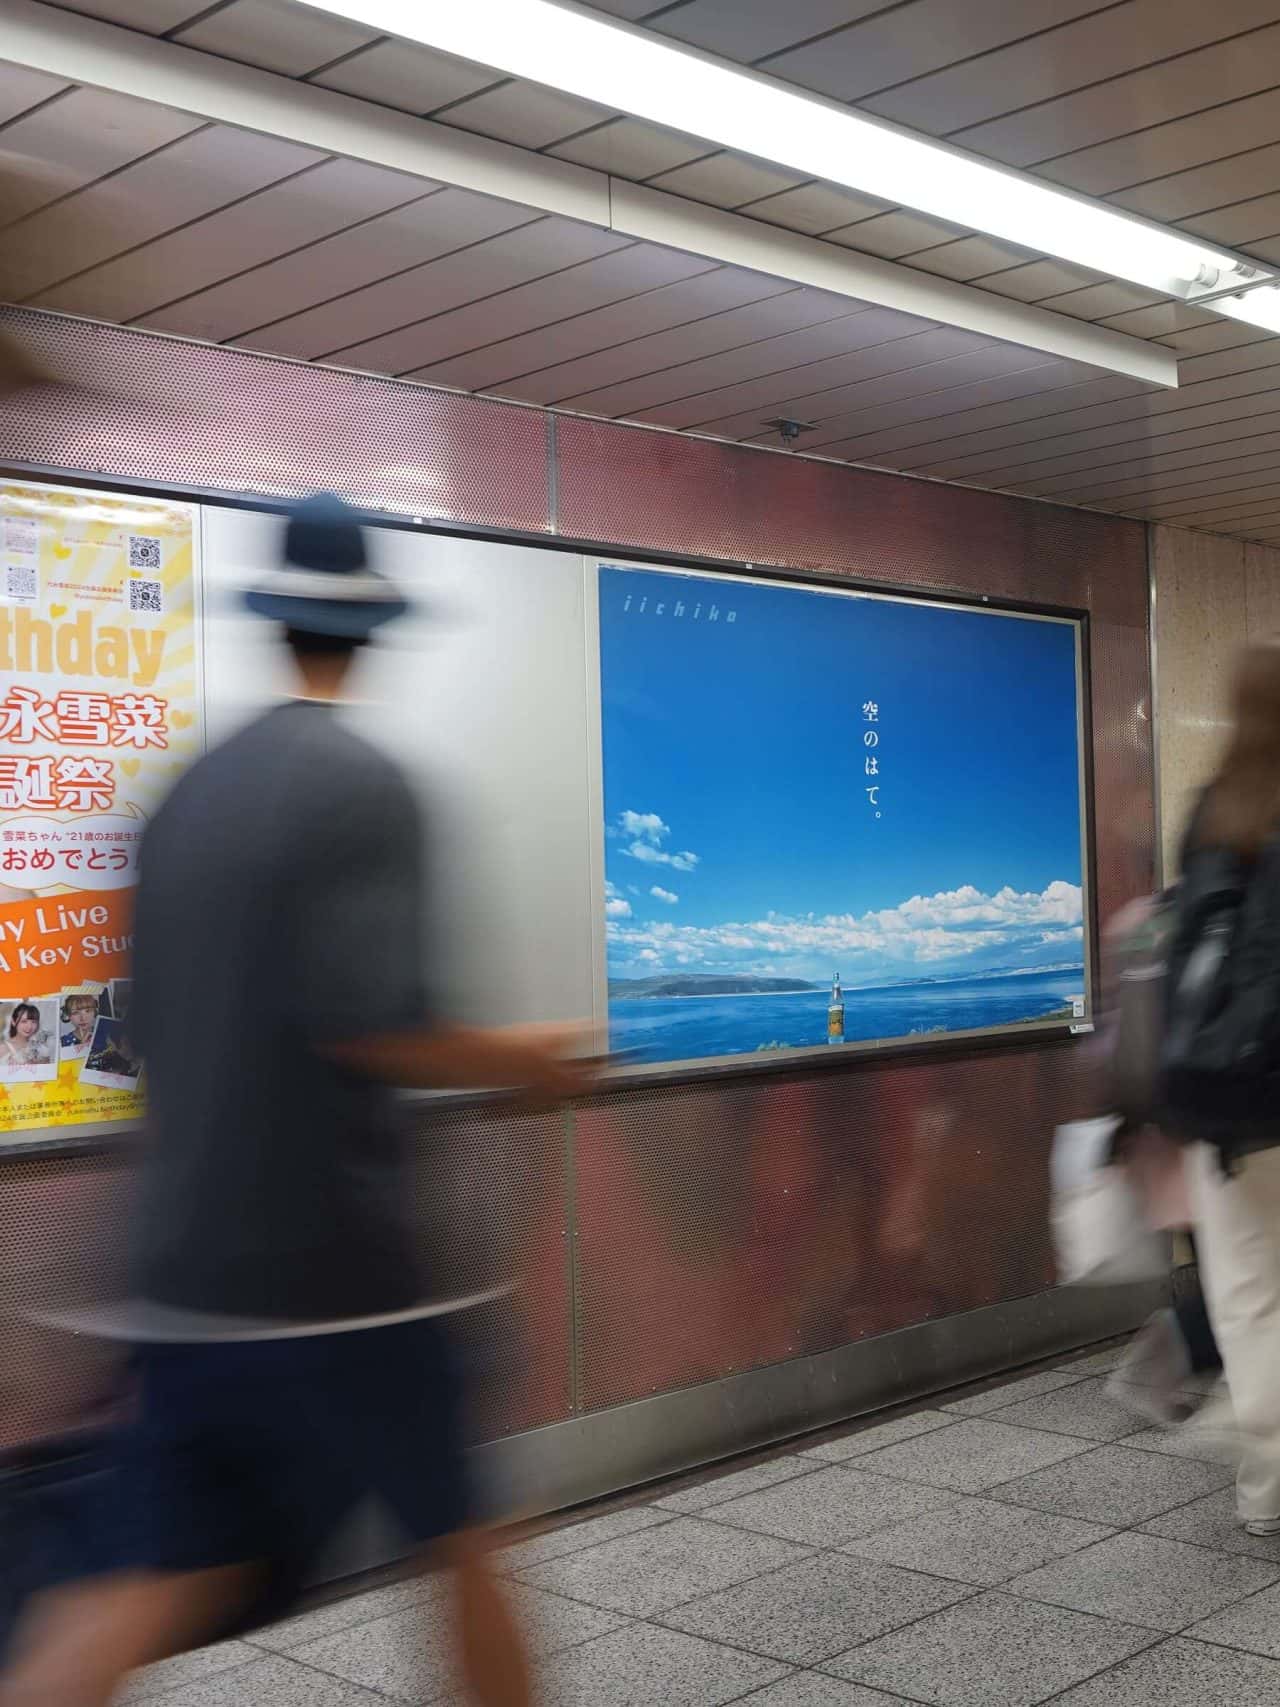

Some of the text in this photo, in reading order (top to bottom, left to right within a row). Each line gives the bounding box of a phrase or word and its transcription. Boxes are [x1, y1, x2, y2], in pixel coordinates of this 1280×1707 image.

[624, 595, 737, 622] iichiko
[0, 686, 168, 749] 永雪菜
[862, 701, 881, 818] 空のはて。
[36, 904, 109, 935] Live
[18, 945, 73, 970] Key
